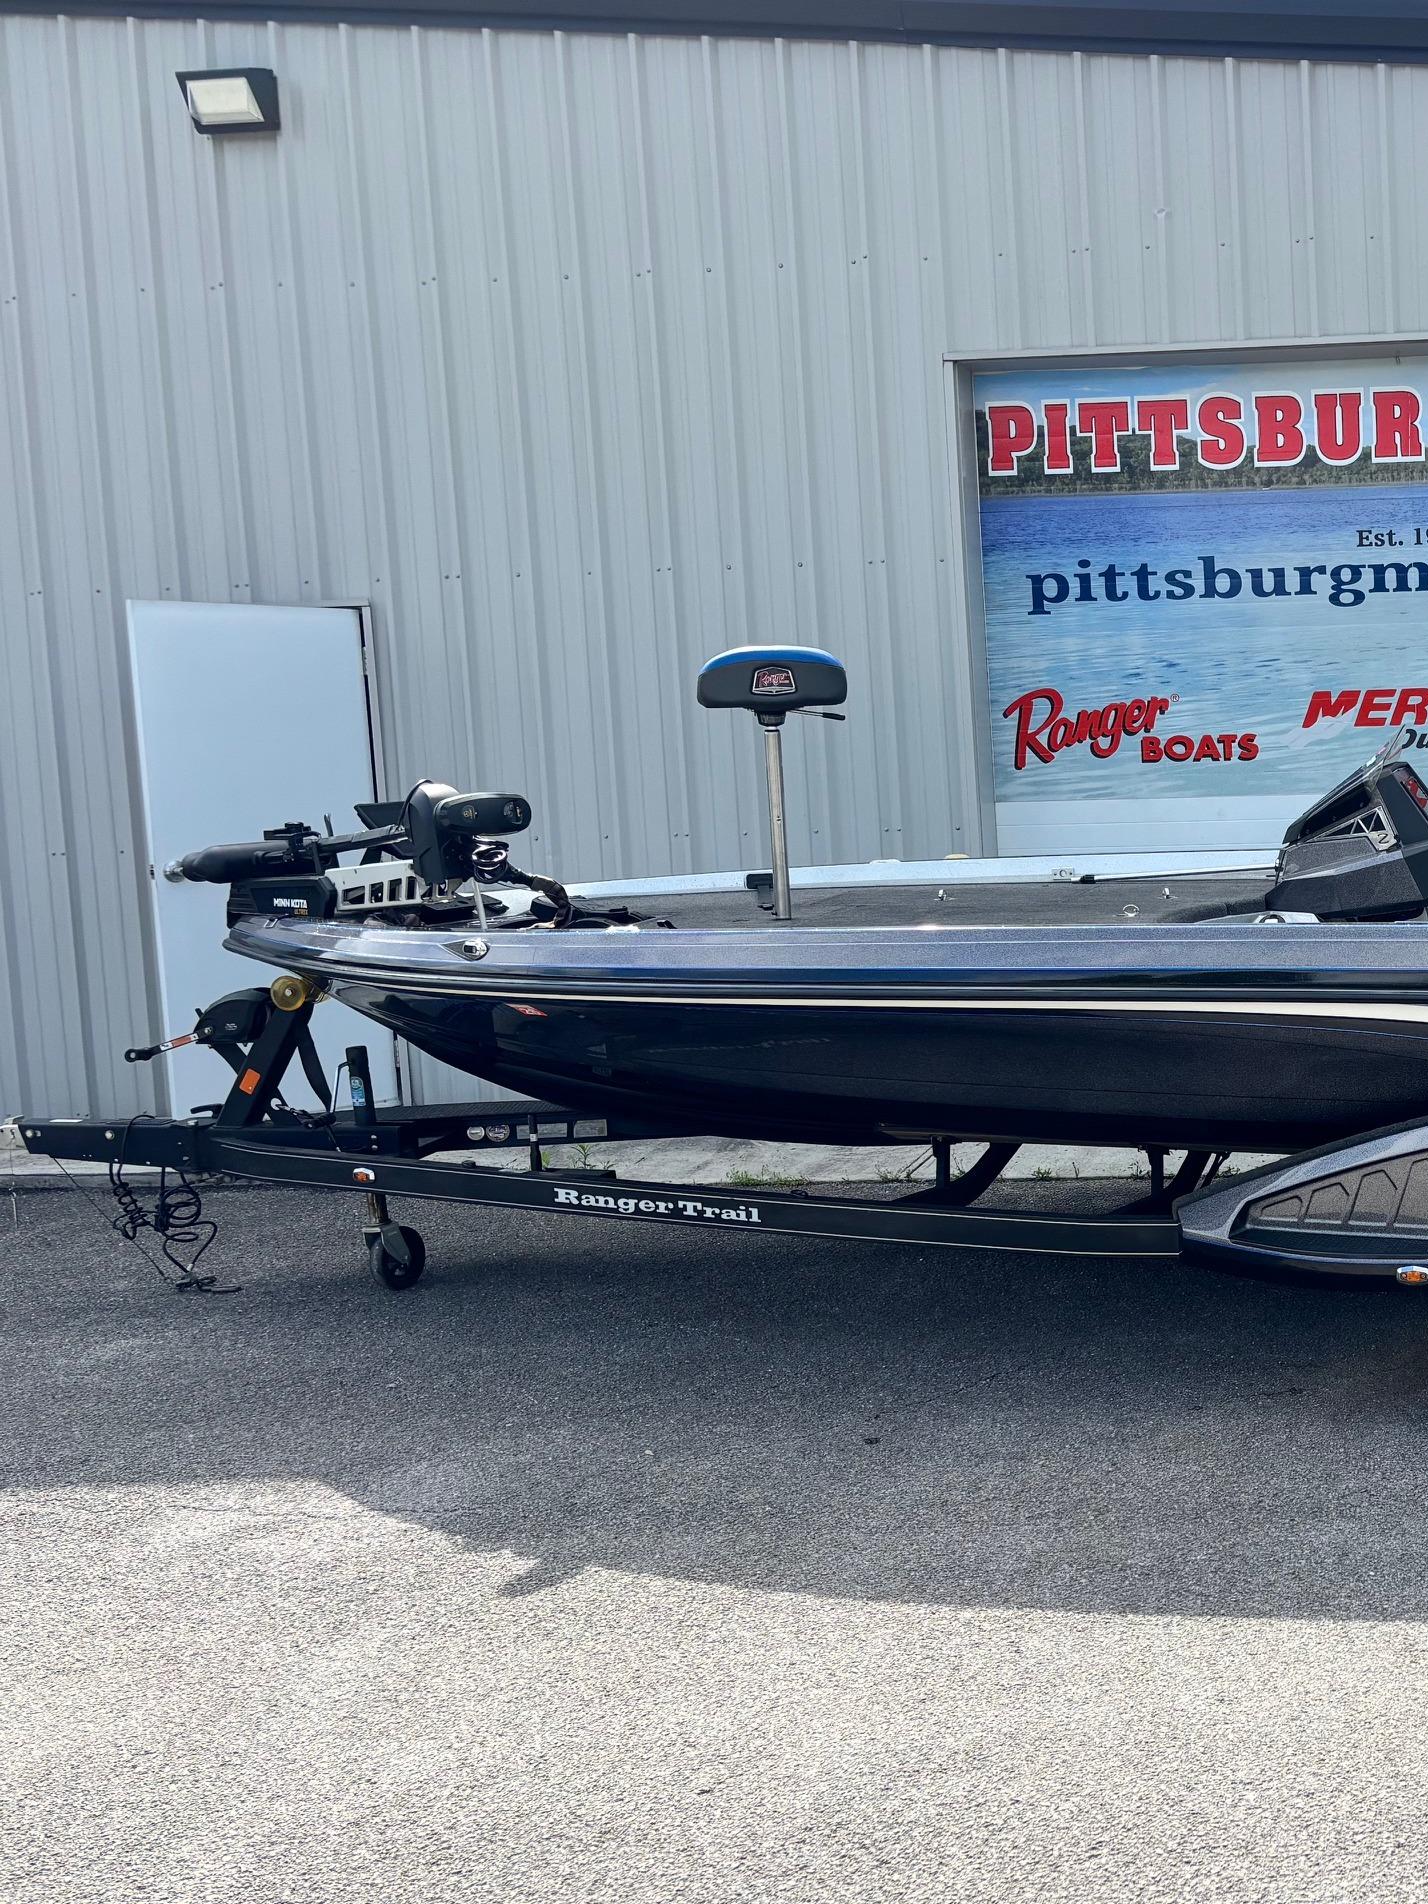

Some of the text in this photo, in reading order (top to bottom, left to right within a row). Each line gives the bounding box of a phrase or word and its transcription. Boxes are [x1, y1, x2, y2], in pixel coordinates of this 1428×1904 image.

[1356, 529, 1404, 547] Est.
[1002, 688, 1169, 770] Ranger
[1141, 733, 1260, 764] BOATS
[273, 898, 308, 909] MINN KOTA
[553, 1187, 762, 1223] Ranger Trail
